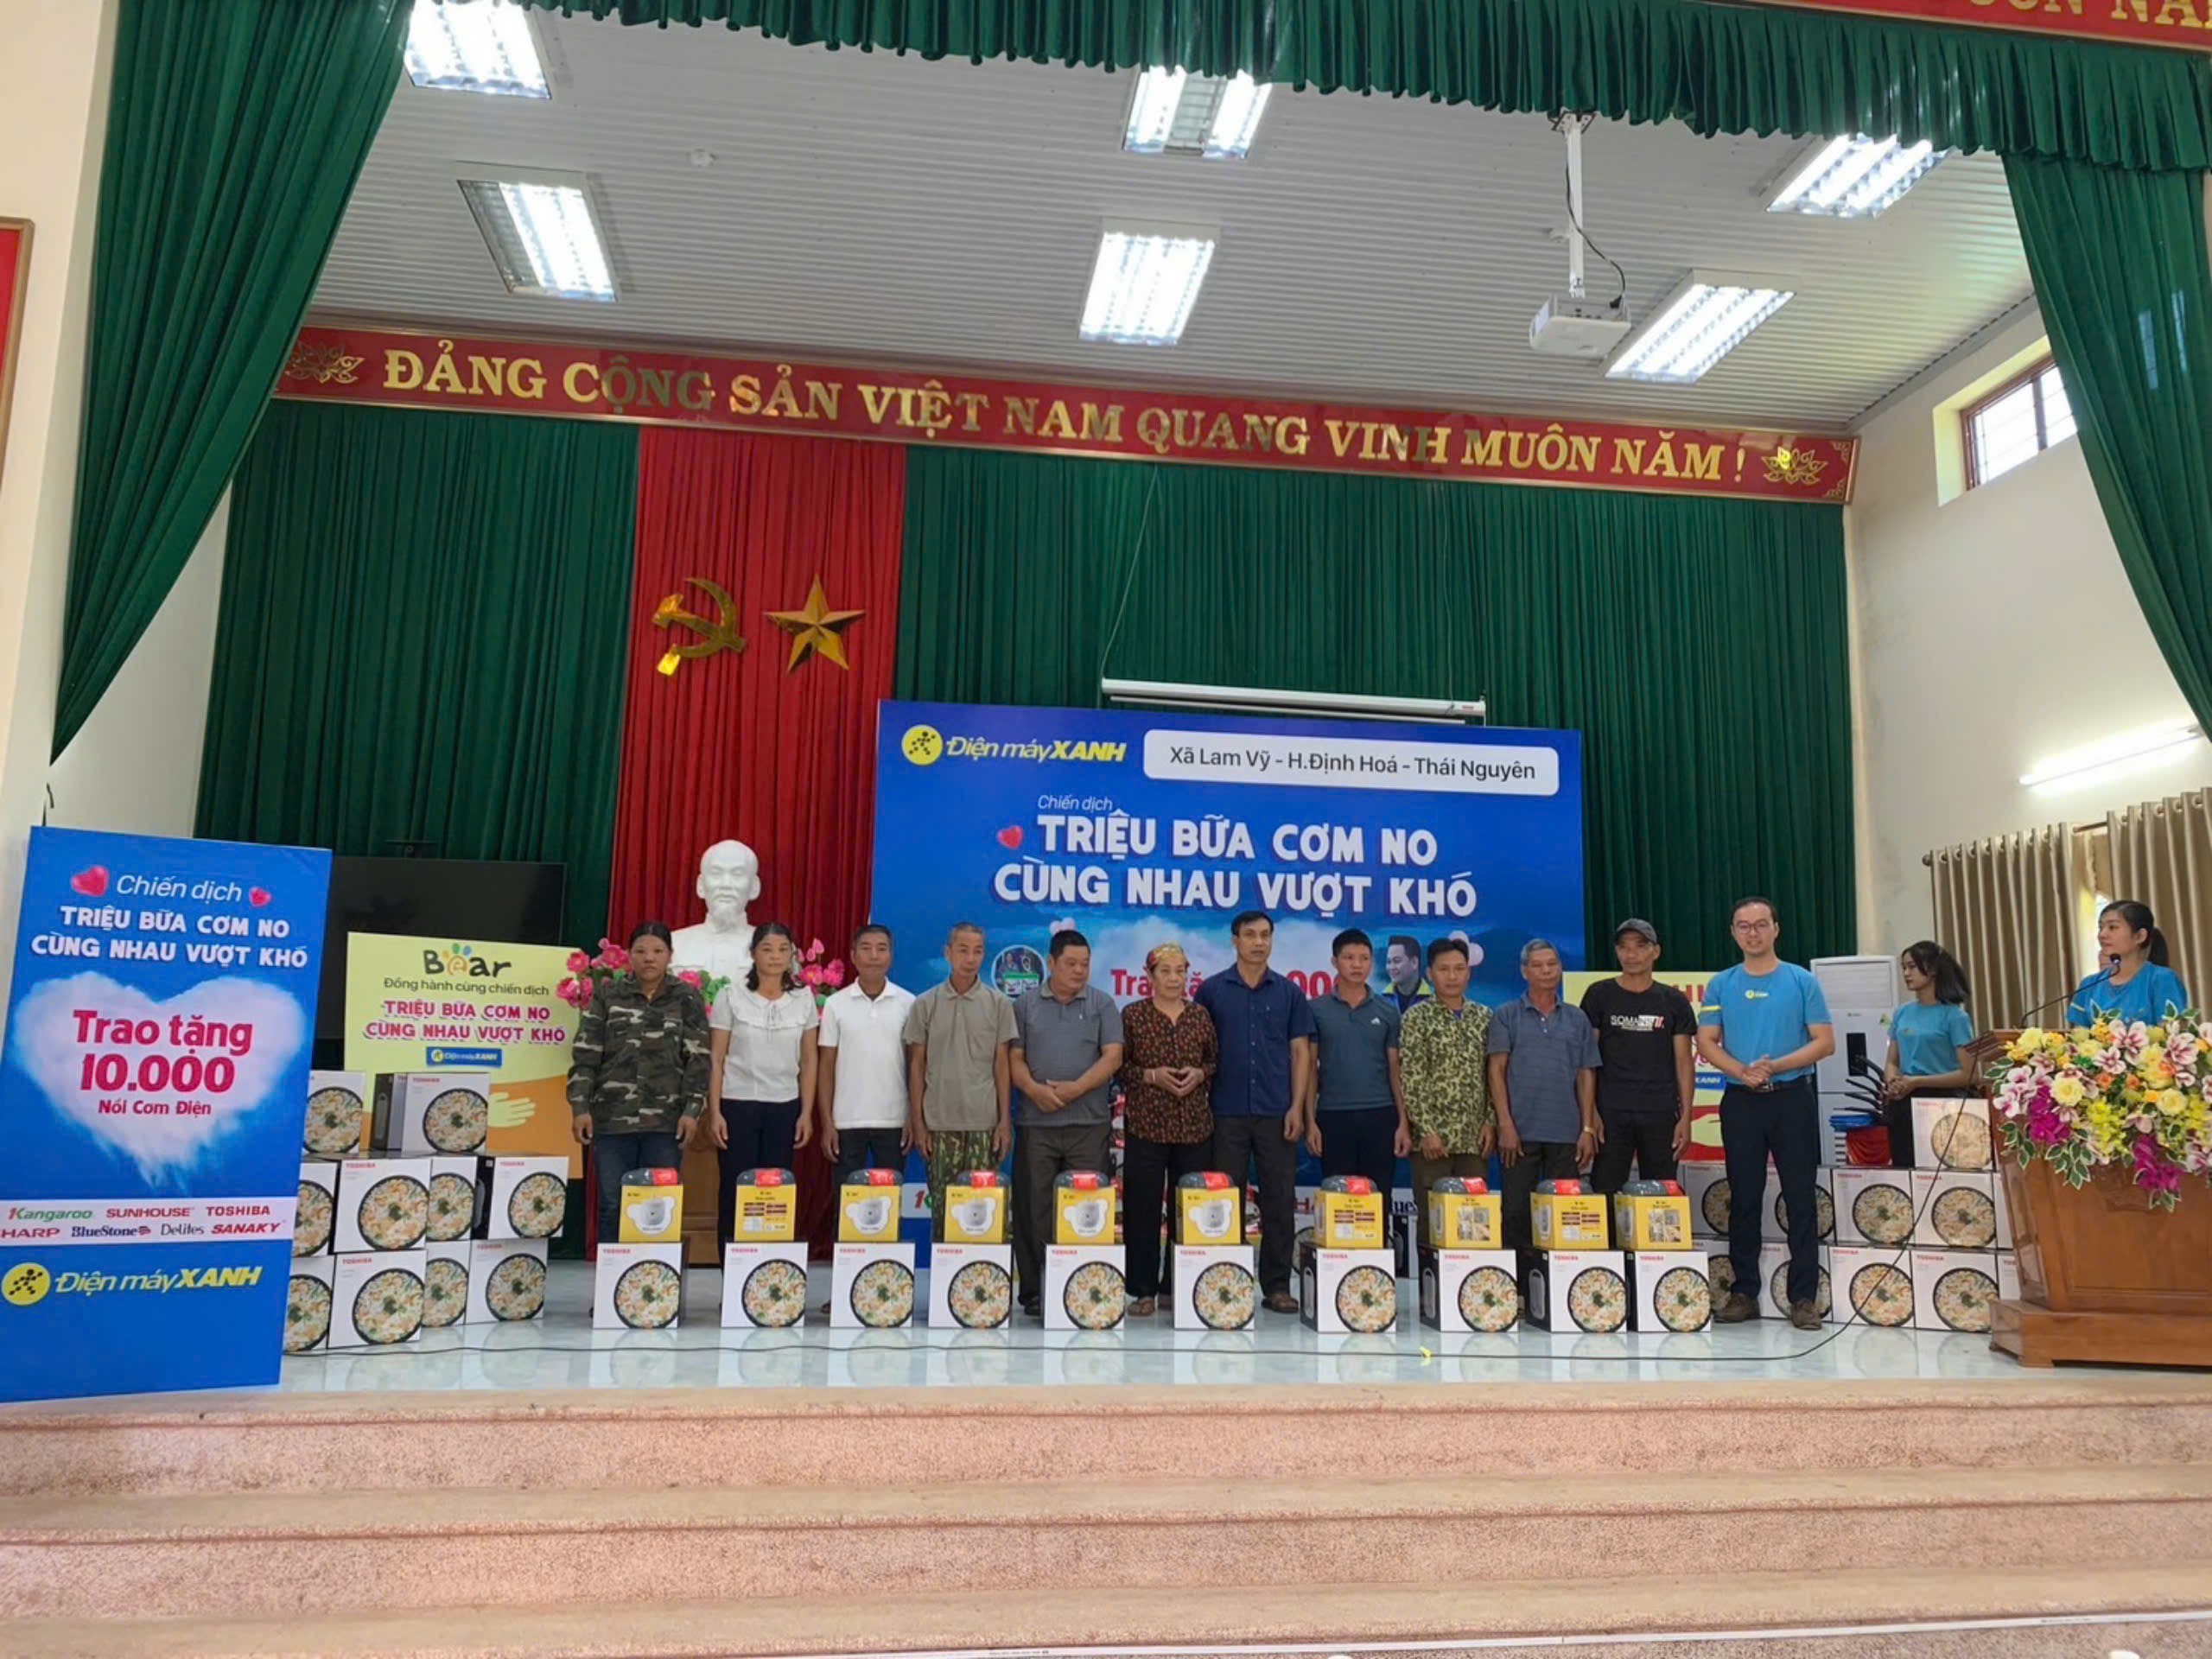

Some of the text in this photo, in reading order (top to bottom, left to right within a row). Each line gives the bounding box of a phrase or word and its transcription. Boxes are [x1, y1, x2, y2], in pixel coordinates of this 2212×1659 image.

[384, 340, 547, 398] ĐẢNG
[563, 354, 715, 414] CỘNG
[729, 364, 842, 420] SẢN
[858, 379, 989, 438] VIỆT
[1002, 397, 1124, 442] NAM
[1136, 407, 1311, 454] QUANG
[1325, 418, 1451, 464] VINH
[1460, 423, 1601, 473] MUÔN
[1611, 430, 1726, 480] NĂM
[946, 735, 998, 760] Điện
[1169, 746, 1195, 765] Xã
[1199, 748, 1241, 766] Lam
[1245, 748, 1270, 771] Vỹ
[1287, 753, 1355, 774] H.Định
[1360, 754, 1397, 773] Hoá
[1414, 757, 1456, 776] Thái
[1460, 760, 1535, 783] Nguyên
[1038, 794, 1112, 813] Chiến dịch
[1037, 809, 1438, 866] TRIỆU BỮA CƠM NO
[116, 874, 242, 903] Chiến dịch
[995, 855, 1477, 918] CÙNG NHAU VƯỢT KHÓ
[60, 905, 289, 938] TRIỆU BỮA CƠM NO
[31, 931, 308, 969] CÙNG NHAU VƯỢT KHÓ
[423, 950, 512, 978] Bear
[421, 979, 453, 991] hành
[455, 982, 486, 995] cùng
[488, 982, 522, 995] chiến
[524, 985, 550, 996] dịch
[1110, 969, 1153, 997] Tra
[384, 999, 435, 1018] TRIỆU
[483, 1005, 521, 1020] CƠM
[528, 1007, 550, 1020] NO
[73, 1009, 253, 1057] Trao tặng
[365, 1020, 566, 1043] CÙNG NHAU VƯỢT KHÓ
[80, 1053, 235, 1093] 10.000
[175, 1101, 212, 1118] Điện
[8, 1205, 270, 1223] Kangaroo SUNHOUSE TOSHIBA
[0, 1228, 60, 1238] HARP
[72, 1224, 137, 1238] BlueStone
[211, 1223, 281, 1235] SANAKY
[55, 1271, 118, 1296] Điện
